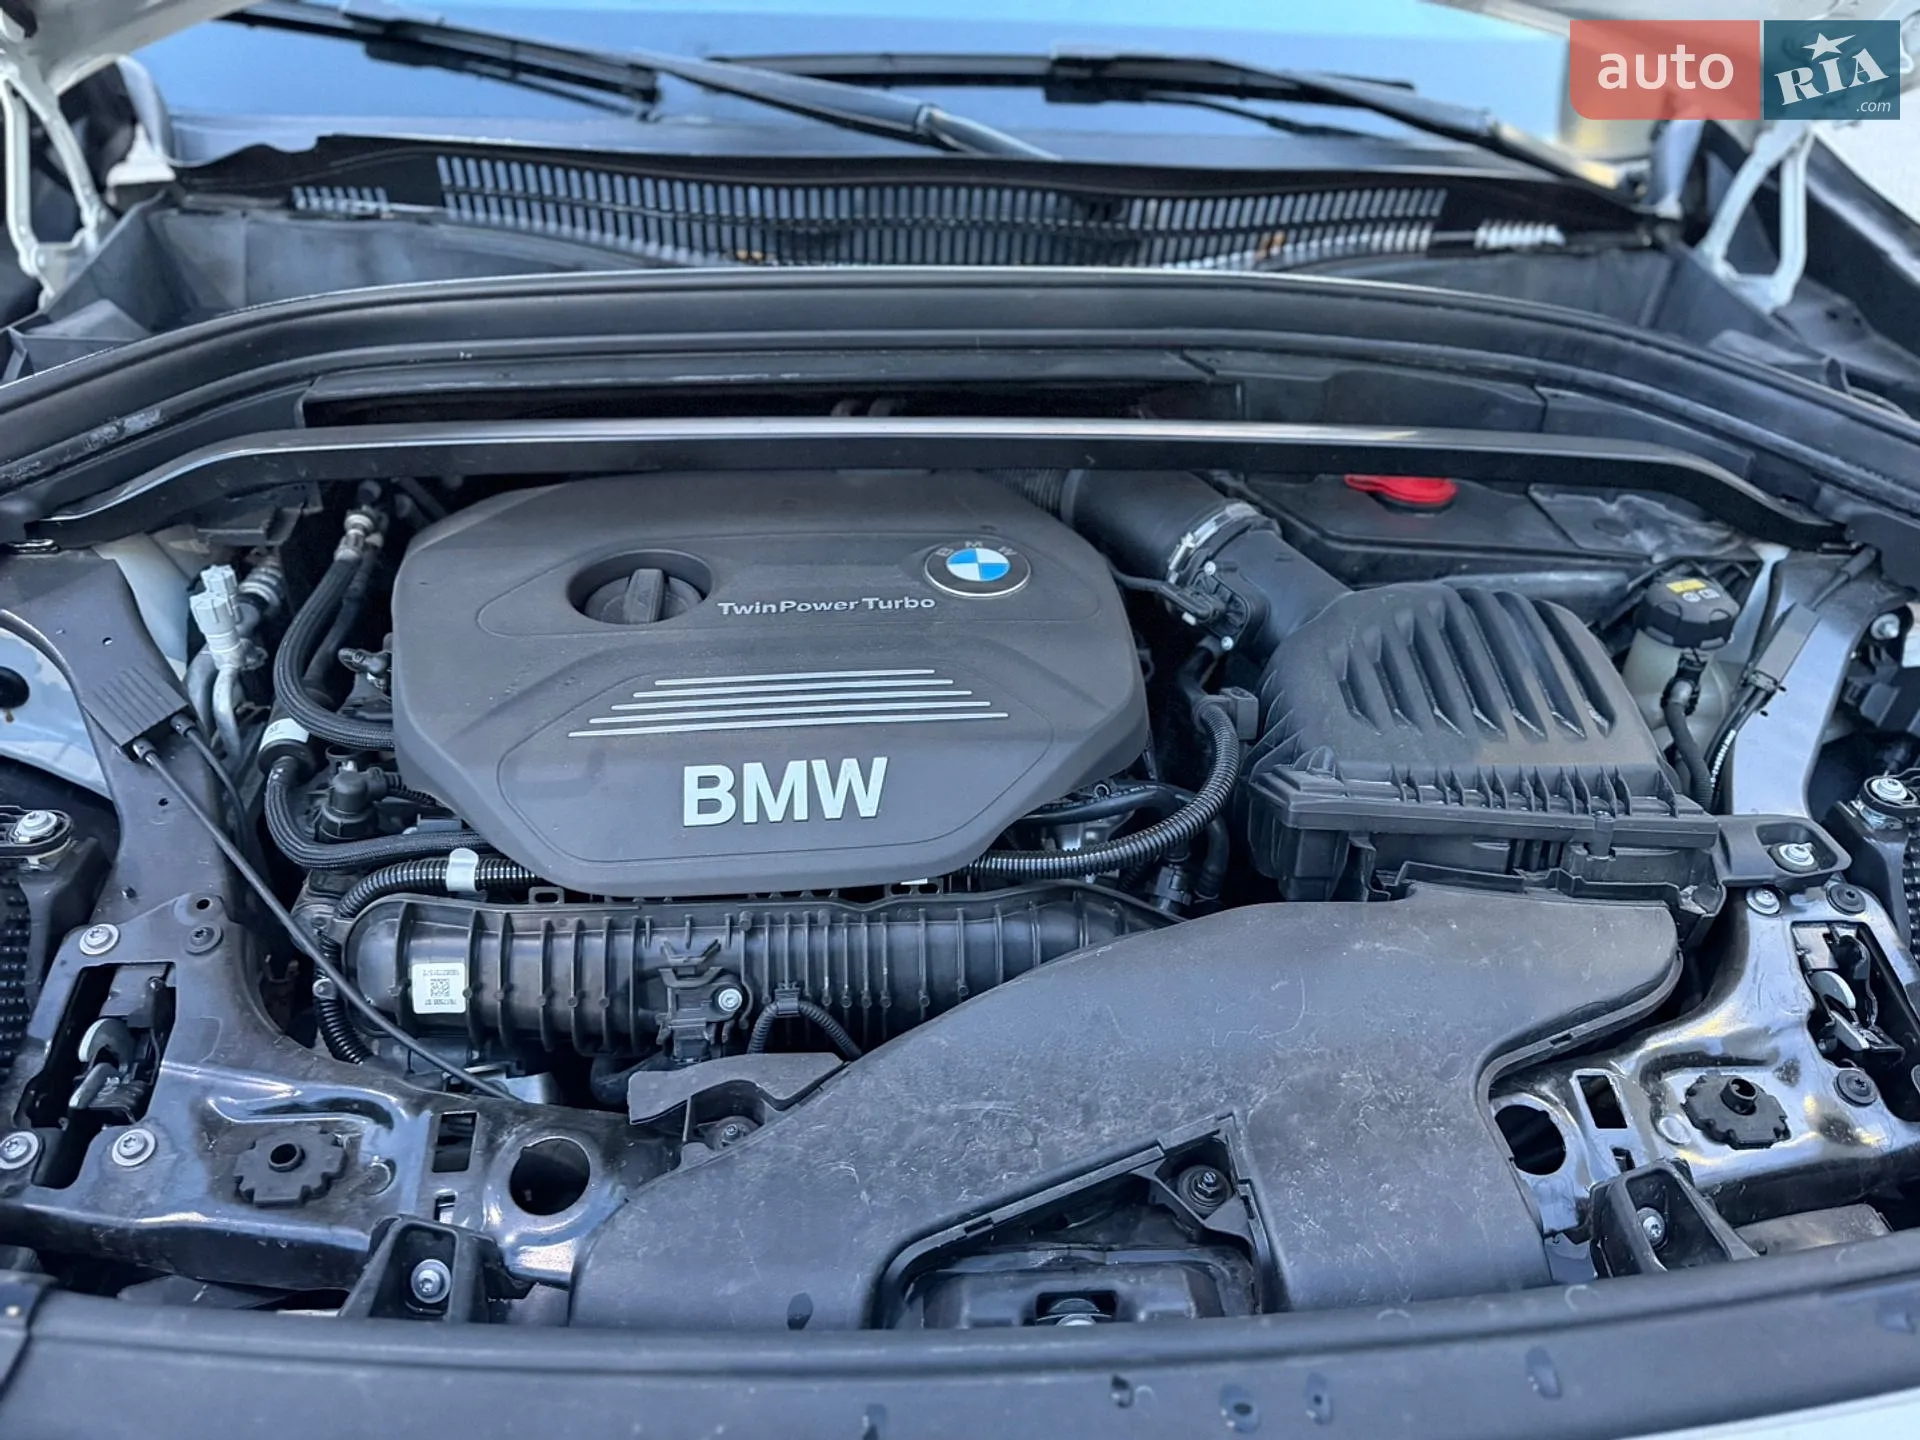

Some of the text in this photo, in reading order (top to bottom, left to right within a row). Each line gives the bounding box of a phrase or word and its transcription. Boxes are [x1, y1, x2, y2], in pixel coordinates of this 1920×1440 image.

[934, 540, 1018, 557] BMW
[861, 596, 936, 611] Turbo
[683, 756, 888, 827] BMW
